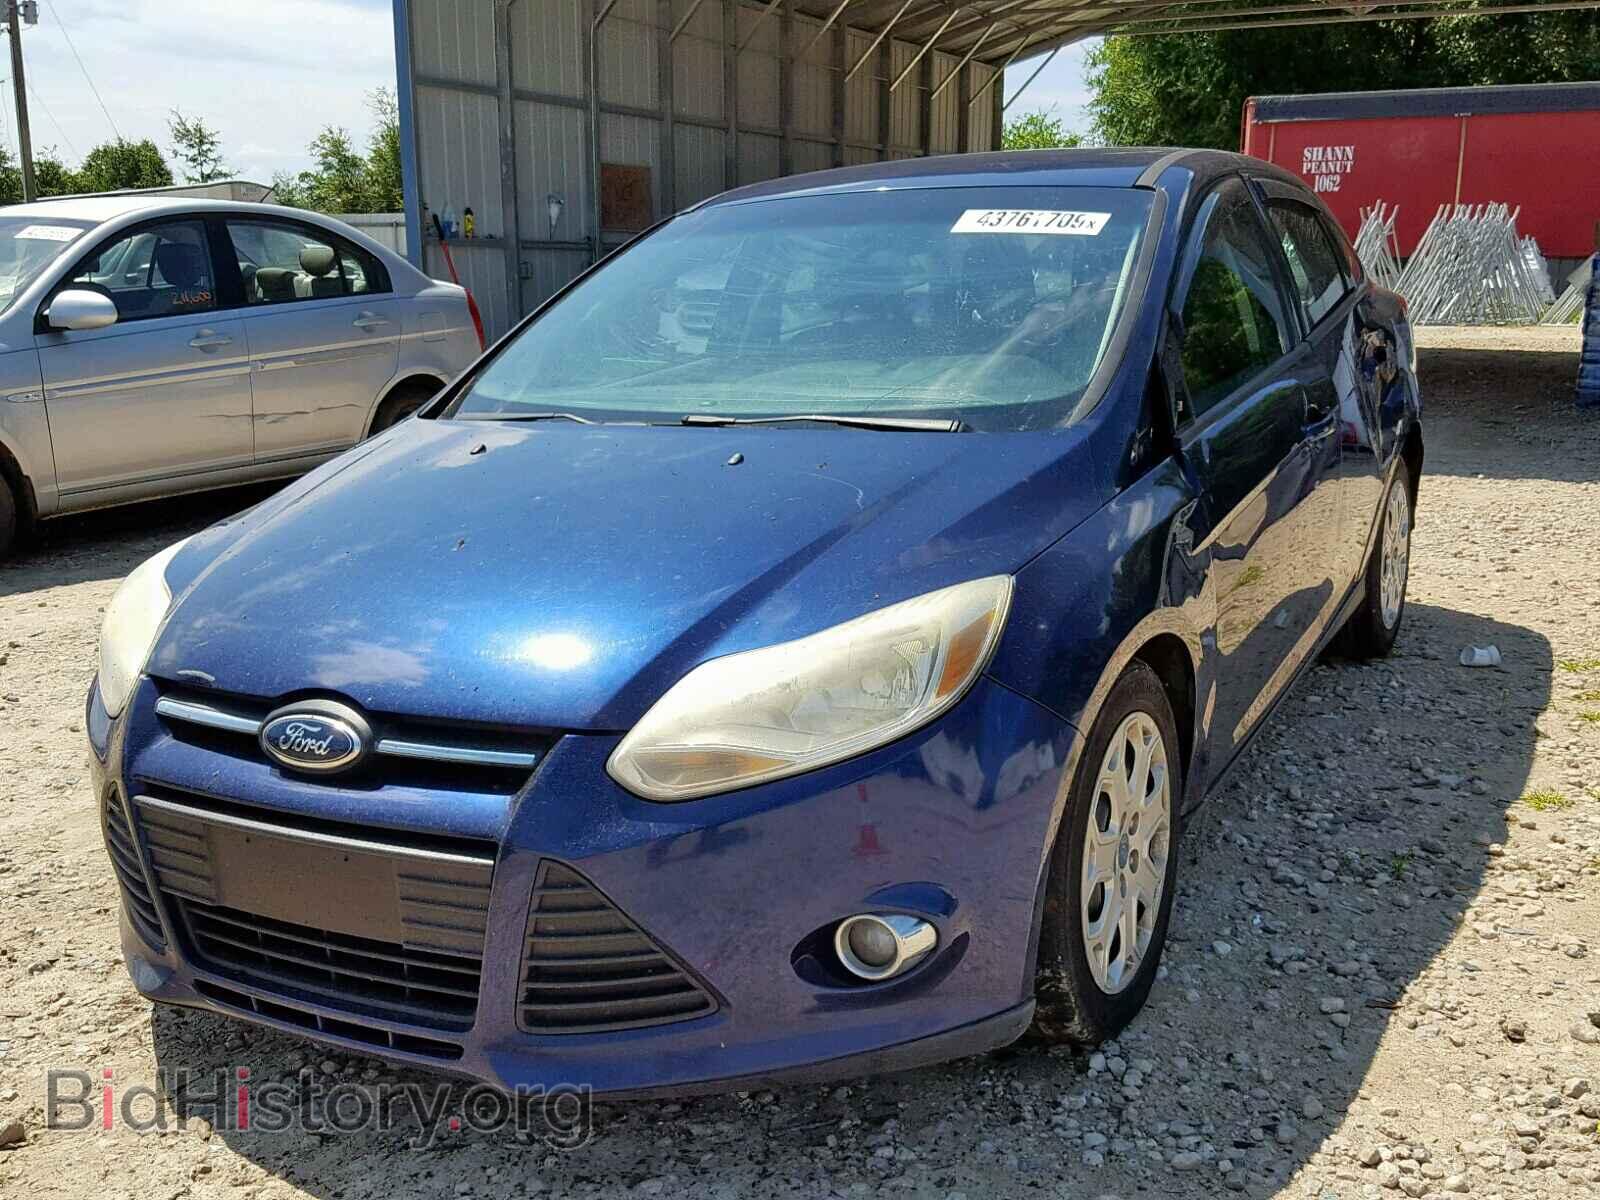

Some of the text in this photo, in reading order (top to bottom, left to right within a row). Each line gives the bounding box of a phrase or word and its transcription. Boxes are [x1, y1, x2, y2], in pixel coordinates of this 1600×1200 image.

[1303, 146, 1355, 161] SHANN
[1303, 161, 1354, 175] PEANUT
[1314, 175, 1341, 192] 1062
[279, 722, 334, 756] Ford
